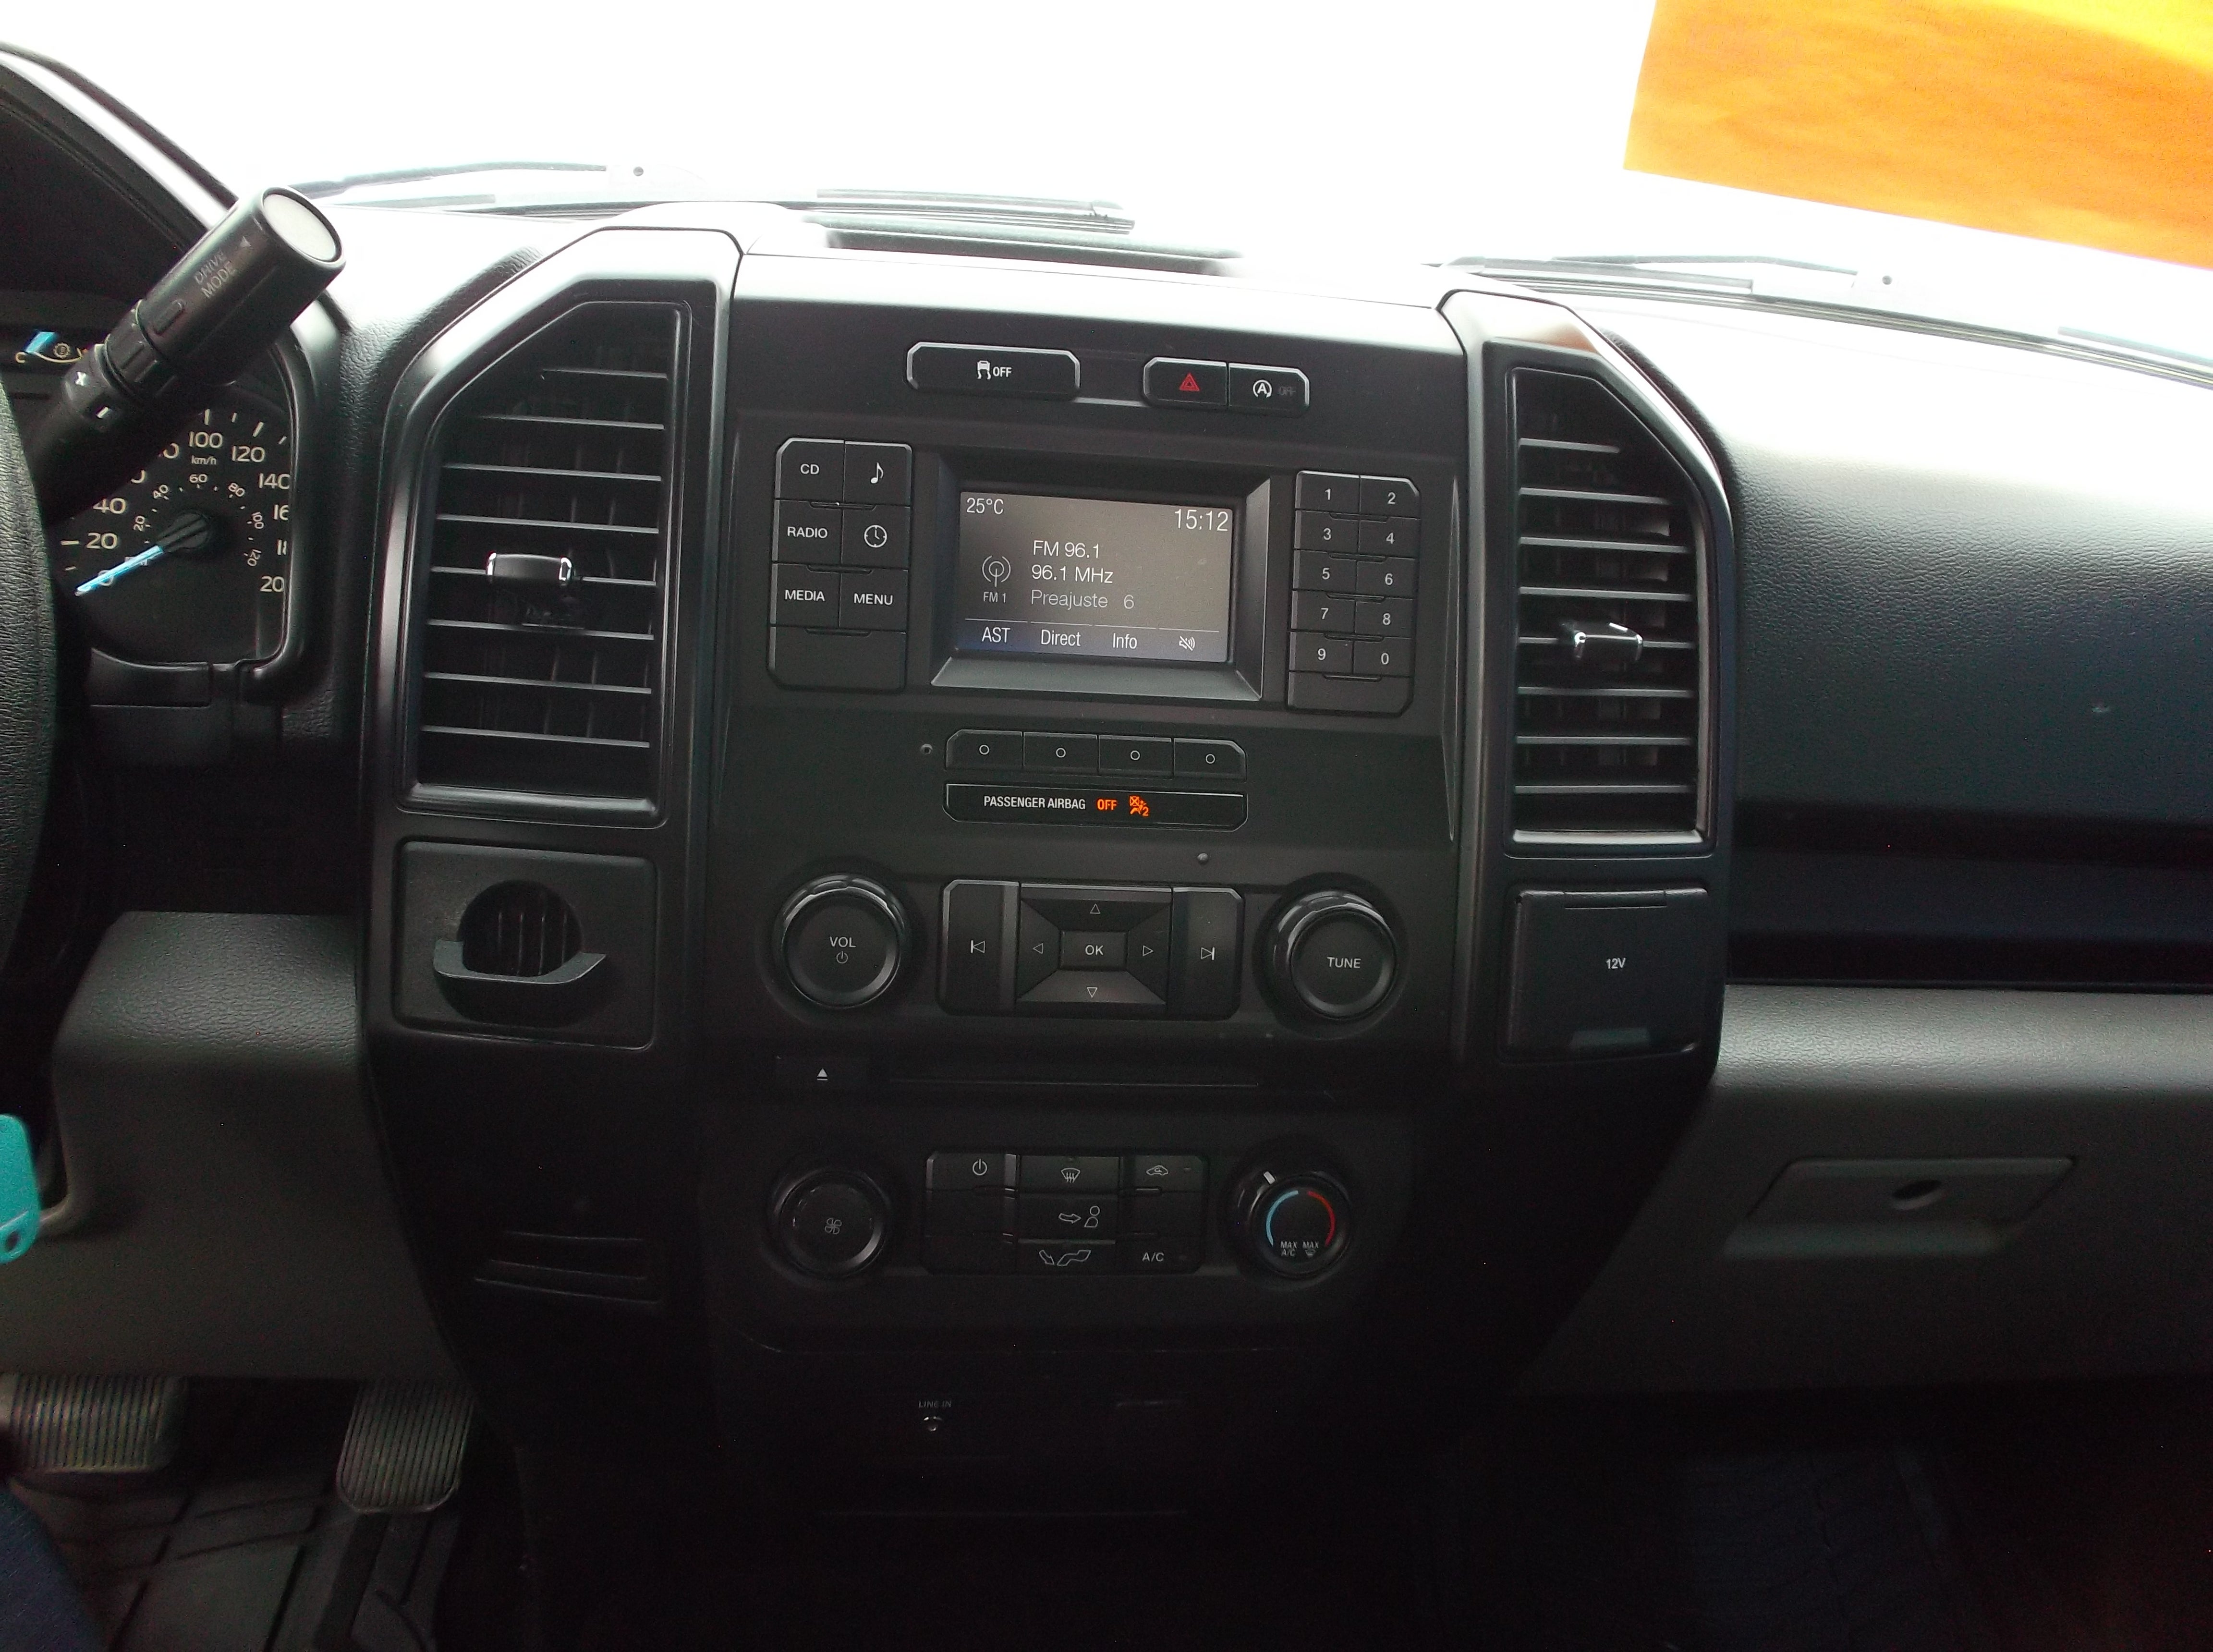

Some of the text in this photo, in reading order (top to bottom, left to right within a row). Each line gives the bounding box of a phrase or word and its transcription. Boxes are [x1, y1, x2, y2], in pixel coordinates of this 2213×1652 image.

[201, 261, 236, 297] MODE
[993, 366, 1012, 377] OFF
[189, 431, 223, 449] 100
[191, 455, 217, 465] km/h
[231, 446, 265, 462] 120
[800, 463, 819, 474] CD
[189, 474, 207, 483] 60
[153, 484, 169, 499] 40
[228, 482, 245, 498] 80
[1325, 488, 1331, 500] 1
[1387, 492, 1396, 504] 2
[92, 498, 127, 515] 40
[273, 504, 289, 521] 16
[967, 498, 1004, 514] 25°C
[133, 515, 145, 532] 20
[251, 511, 264, 529] 100
[1175, 509, 1228, 531] 15:12
[787, 526, 828, 538] RADIO
[1323, 528, 1331, 540] 3
[1386, 532, 1394, 544] 4
[86, 532, 118, 549] 20
[1034, 540, 1099, 559] FM 96.1
[247, 549, 262, 567] 120
[1032, 564, 1114, 583] 96.1 MHz
[1322, 568, 1330, 580] 5
[1385, 573, 1393, 585] 6
[259, 576, 285, 593] 20
[785, 589, 825, 602] MEDIA
[854, 593, 893, 605] MENU
[983, 591, 1006, 603] FM 1
[1032, 589, 1134, 610] Preajuste 6
[1321, 607, 1329, 620] 7
[1383, 613, 1391, 625] 8
[981, 627, 1011, 644] AST
[1041, 629, 1081, 646] Direct
[1113, 632, 1137, 649] Info
[1318, 648, 1326, 660] 9
[1381, 653, 1389, 665] 0
[984, 796, 1117, 811] PASSENGER AIRBAG OFF
[829, 936, 856, 947] VOL
[1085, 945, 1103, 955] OK
[1327, 957, 1361, 969] TUNE
[1606, 958, 1626, 969] 12V
[1142, 1252, 1164, 1262] A/C
